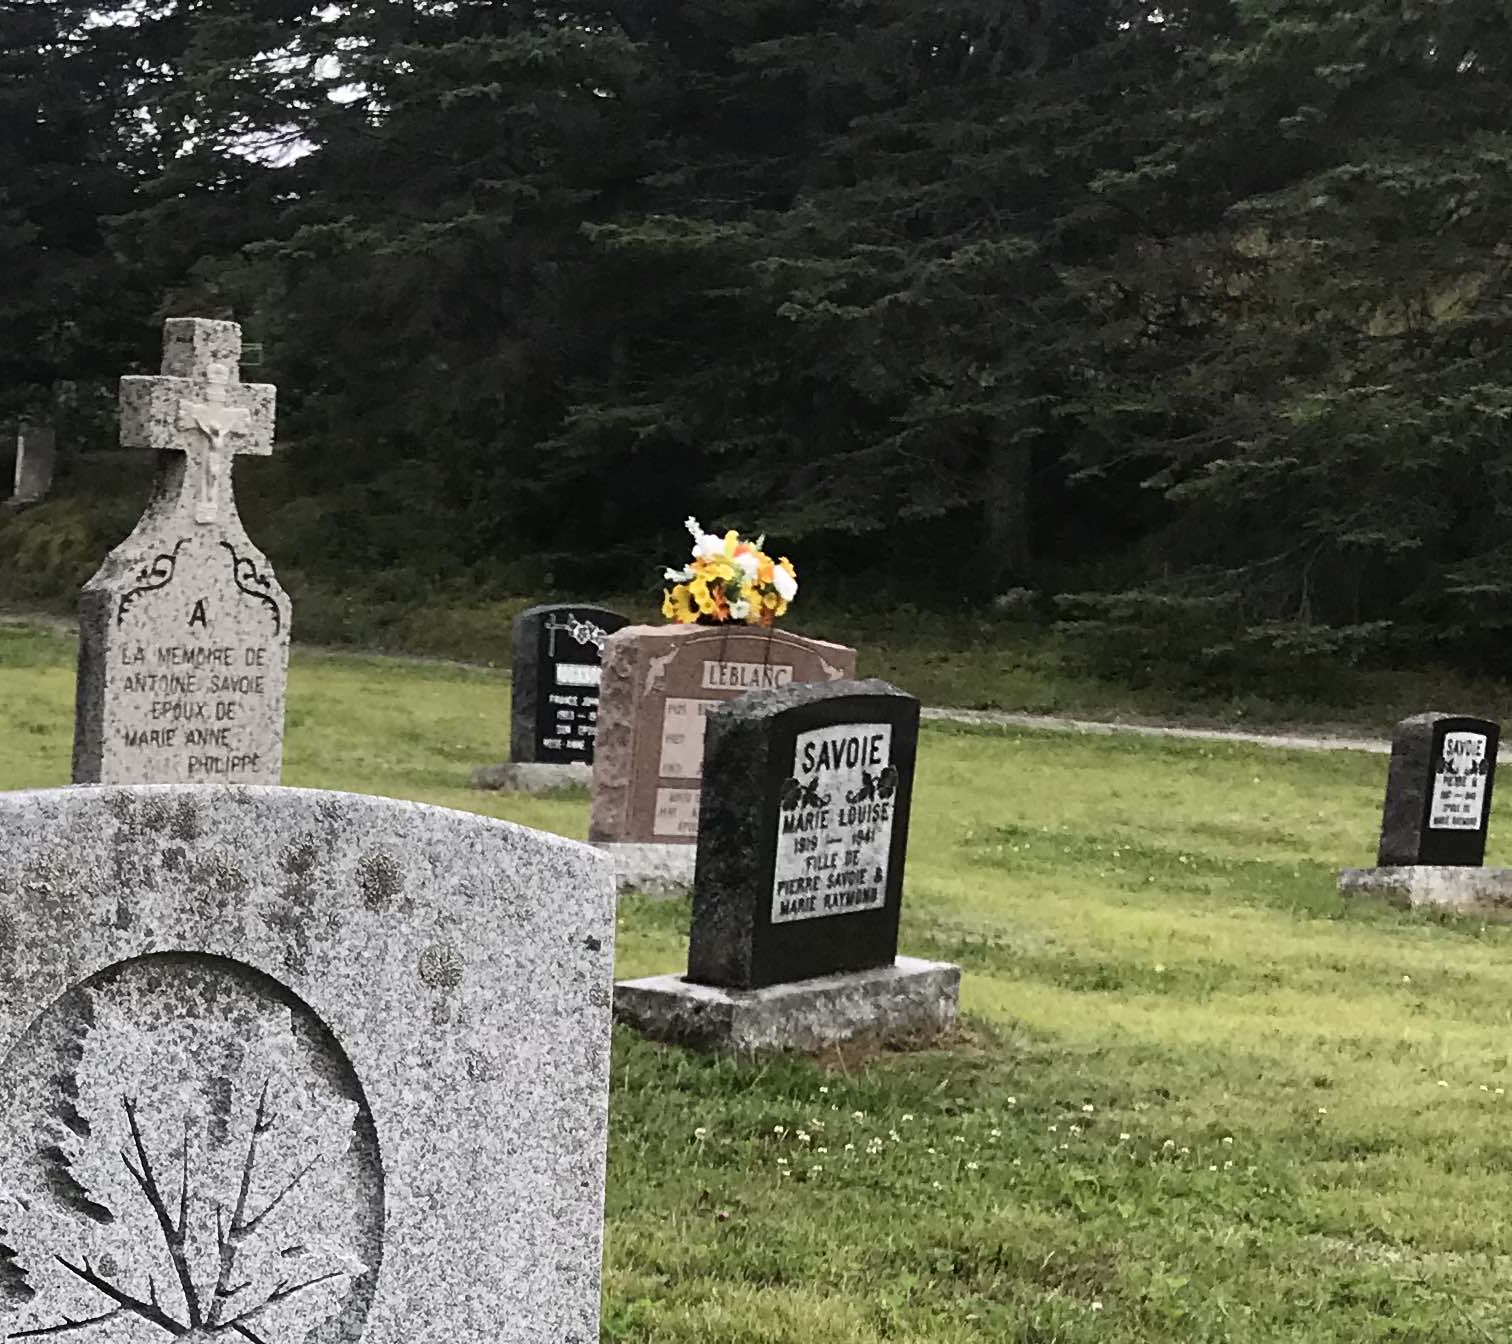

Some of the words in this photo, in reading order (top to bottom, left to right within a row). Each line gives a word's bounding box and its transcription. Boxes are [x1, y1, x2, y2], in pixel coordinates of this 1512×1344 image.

[189, 599, 208, 629] A
[122, 648, 145, 665] LA
[158, 647, 235, 666] MEMOIRE
[245, 648, 266, 666] DE
[124, 674, 197, 694] ANTOINE
[209, 675, 265, 695] SAVOIE
[709, 664, 788, 688] LEBLANC
[152, 701, 205, 720] EPOUX
[216, 702, 236, 721] DE
[124, 728, 176, 749] MARIE
[187, 728, 231, 747] ANNE
[802, 735, 884, 774] SAVOIE
[783, 810, 829, 834] MARIE
[839, 803, 889, 827] LOUISE
[806, 854, 838, 871] FILLE
[845, 850, 860, 867] DE
[777, 876, 820, 896] PIERRE
[826, 868, 867, 889] SAVOIE
[780, 896, 816, 916] MARIE
